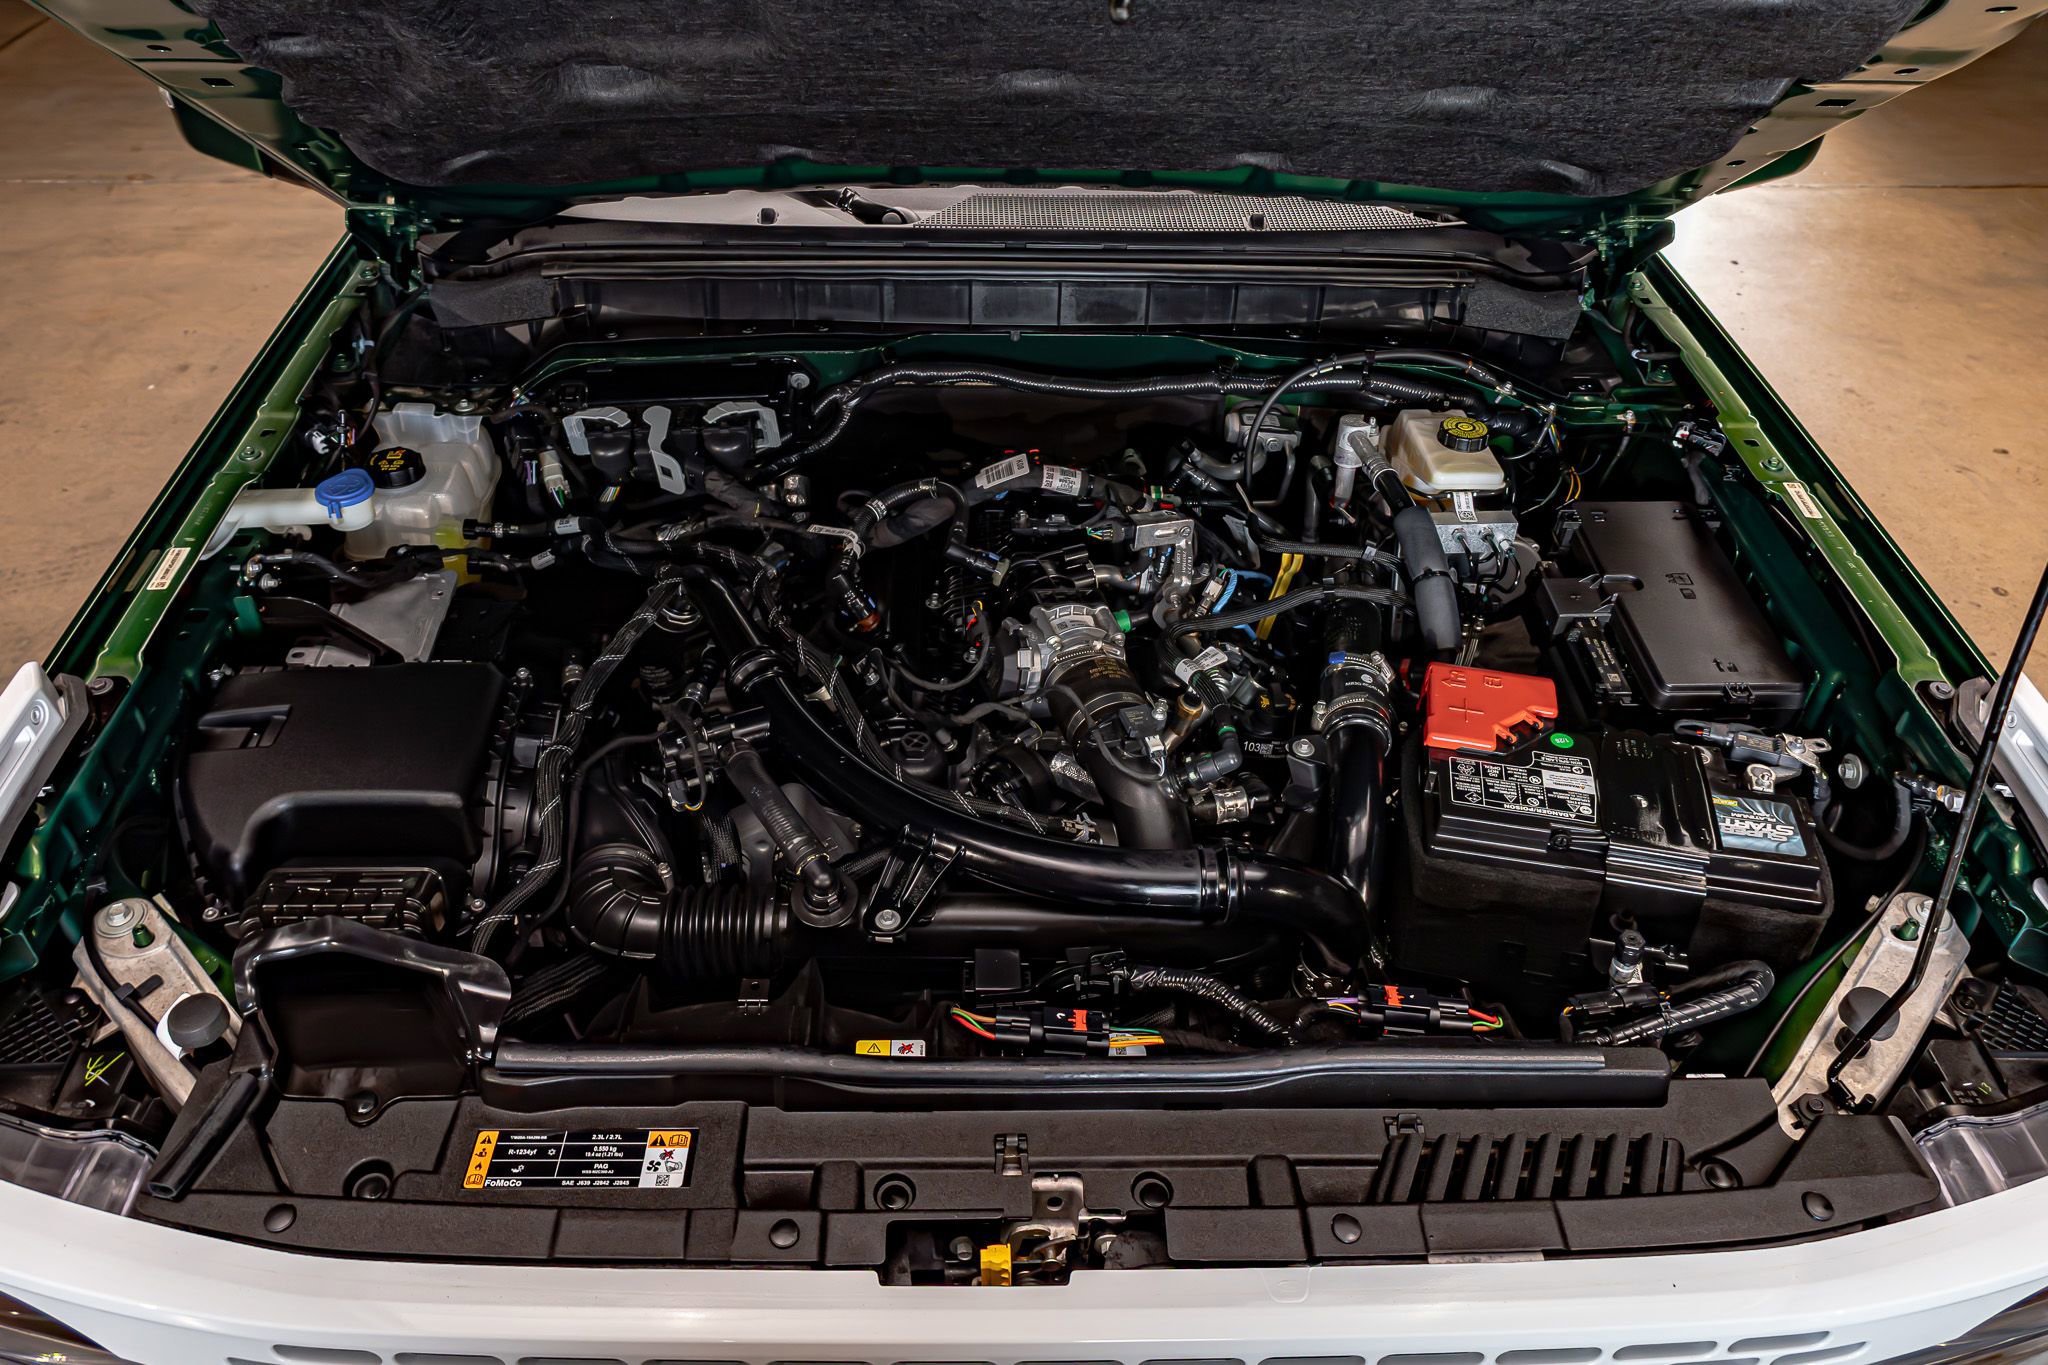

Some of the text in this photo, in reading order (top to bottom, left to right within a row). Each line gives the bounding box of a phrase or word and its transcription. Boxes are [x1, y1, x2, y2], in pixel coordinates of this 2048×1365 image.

[1244, 741, 1260, 752] 103
[1504, 804, 1569, 818] DANGER/POISON
[1730, 812, 1776, 822] PLATINUM
[1719, 817, 1794, 836] START
[1721, 824, 1787, 842] SUPER
